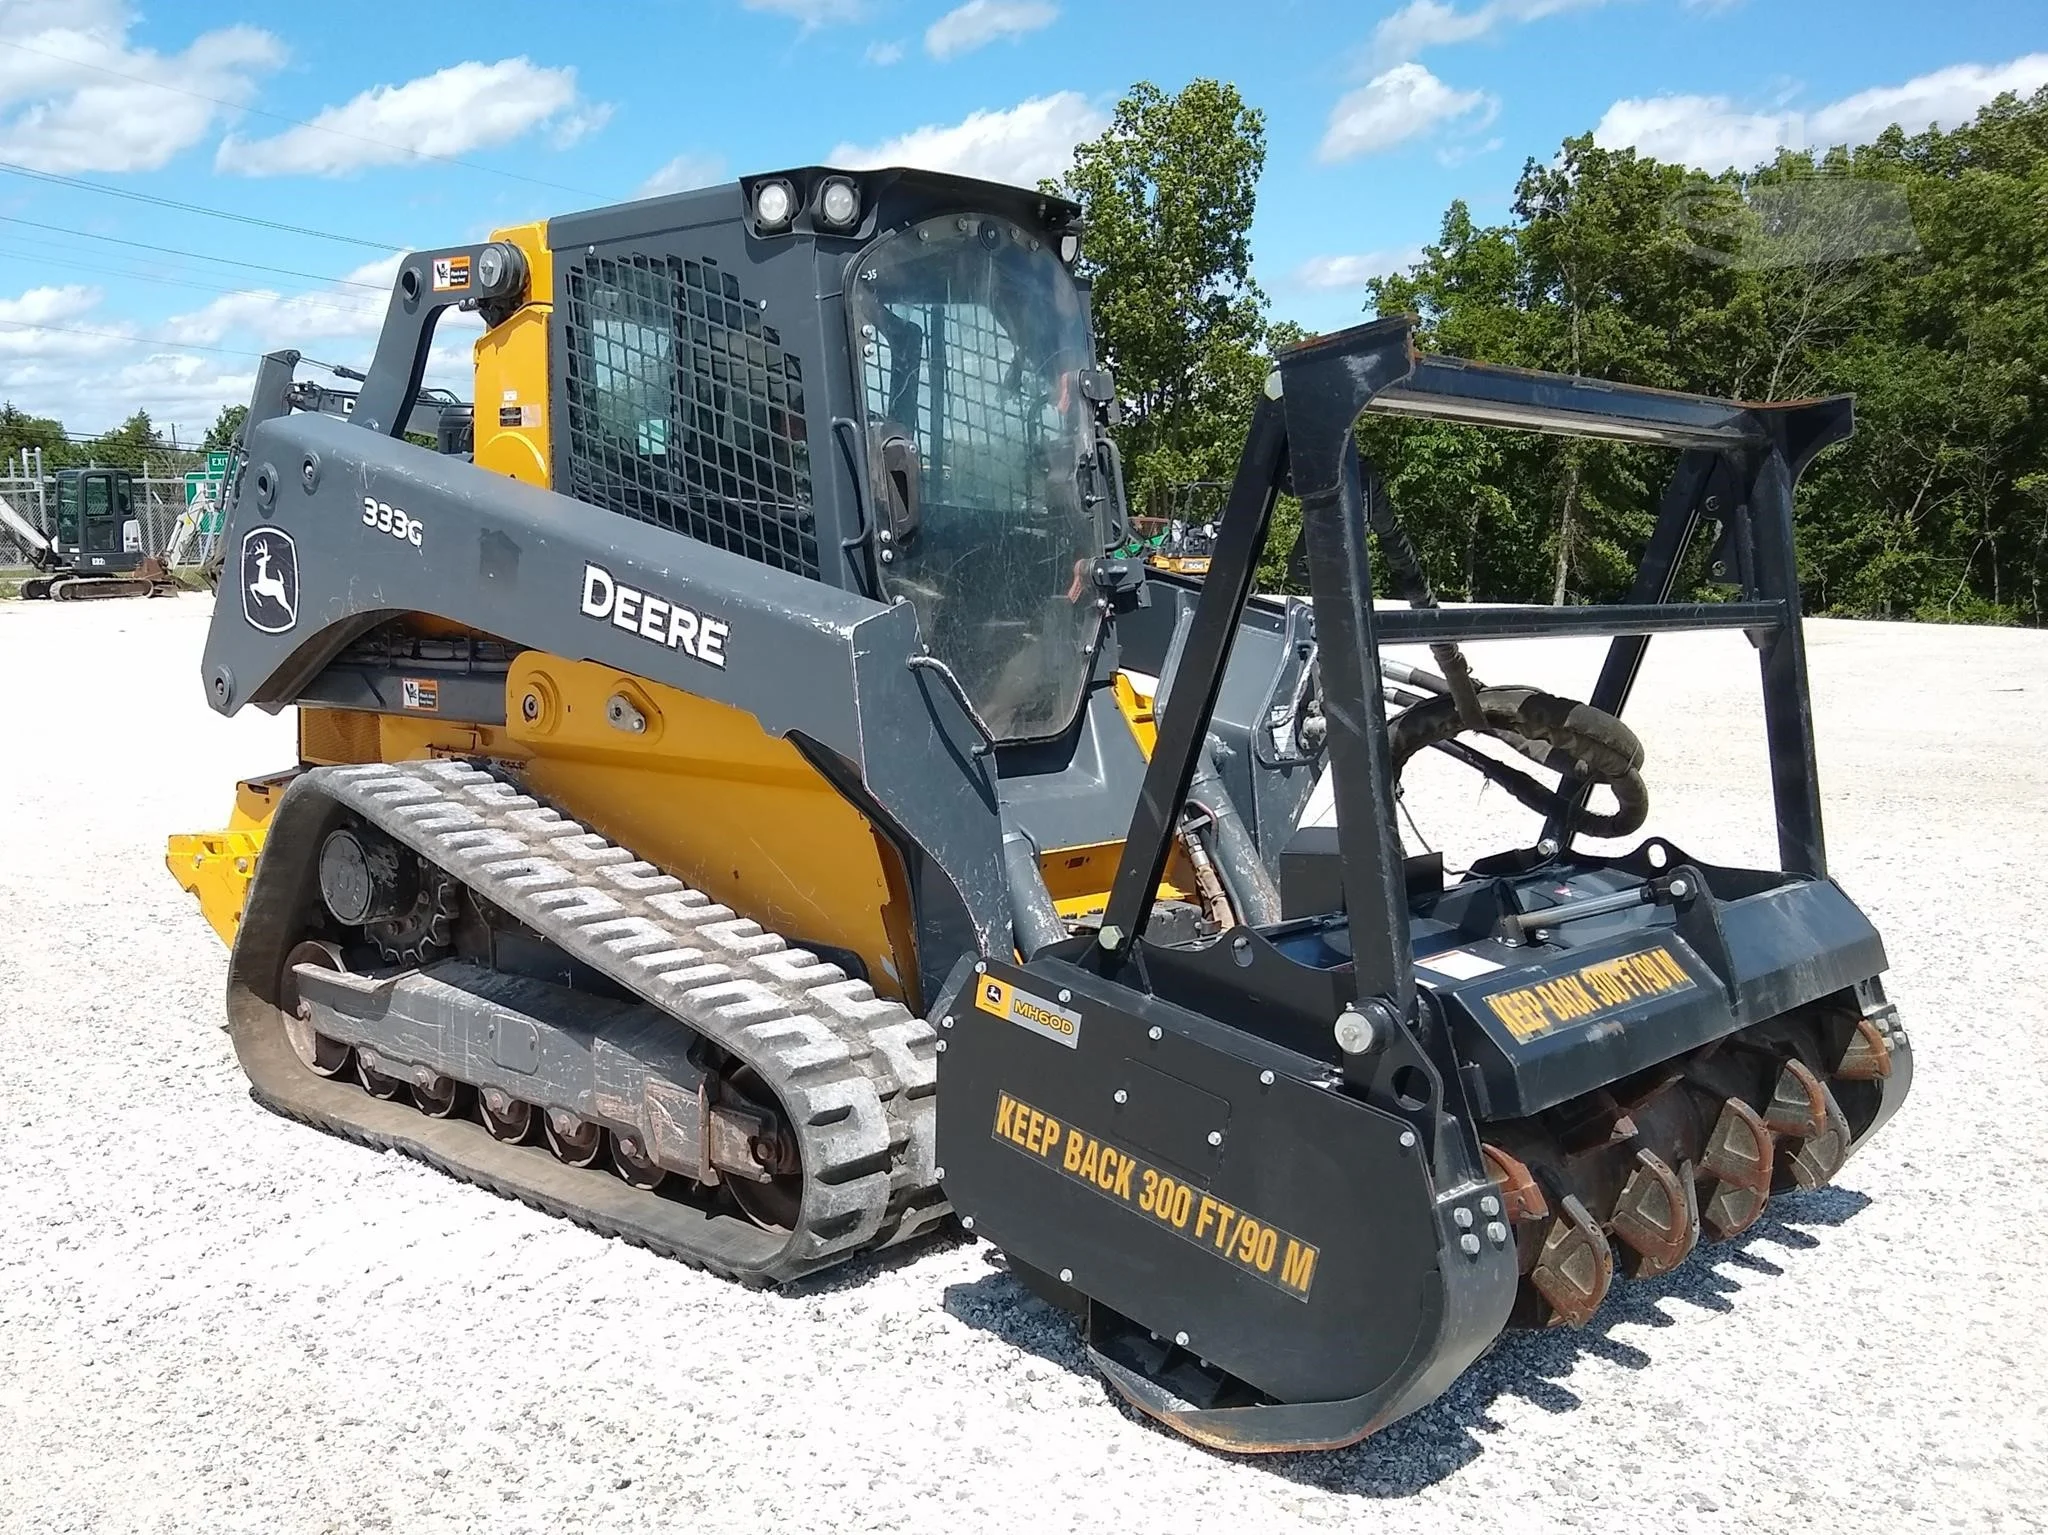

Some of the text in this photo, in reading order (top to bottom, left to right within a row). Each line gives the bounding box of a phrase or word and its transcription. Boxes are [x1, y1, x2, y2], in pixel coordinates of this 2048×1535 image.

[363, 497, 424, 546] 333G
[581, 565, 729, 667] DEERE
[1014, 999, 1074, 1036] MH60D
[1488, 990, 1550, 1036] KEEP
[1536, 975, 1601, 1021] BACK
[1583, 969, 1629, 1006] 300
[1652, 946, 1689, 982] M
[995, 1095, 1316, 1292] KEEP BACK 300 FT/90 M
